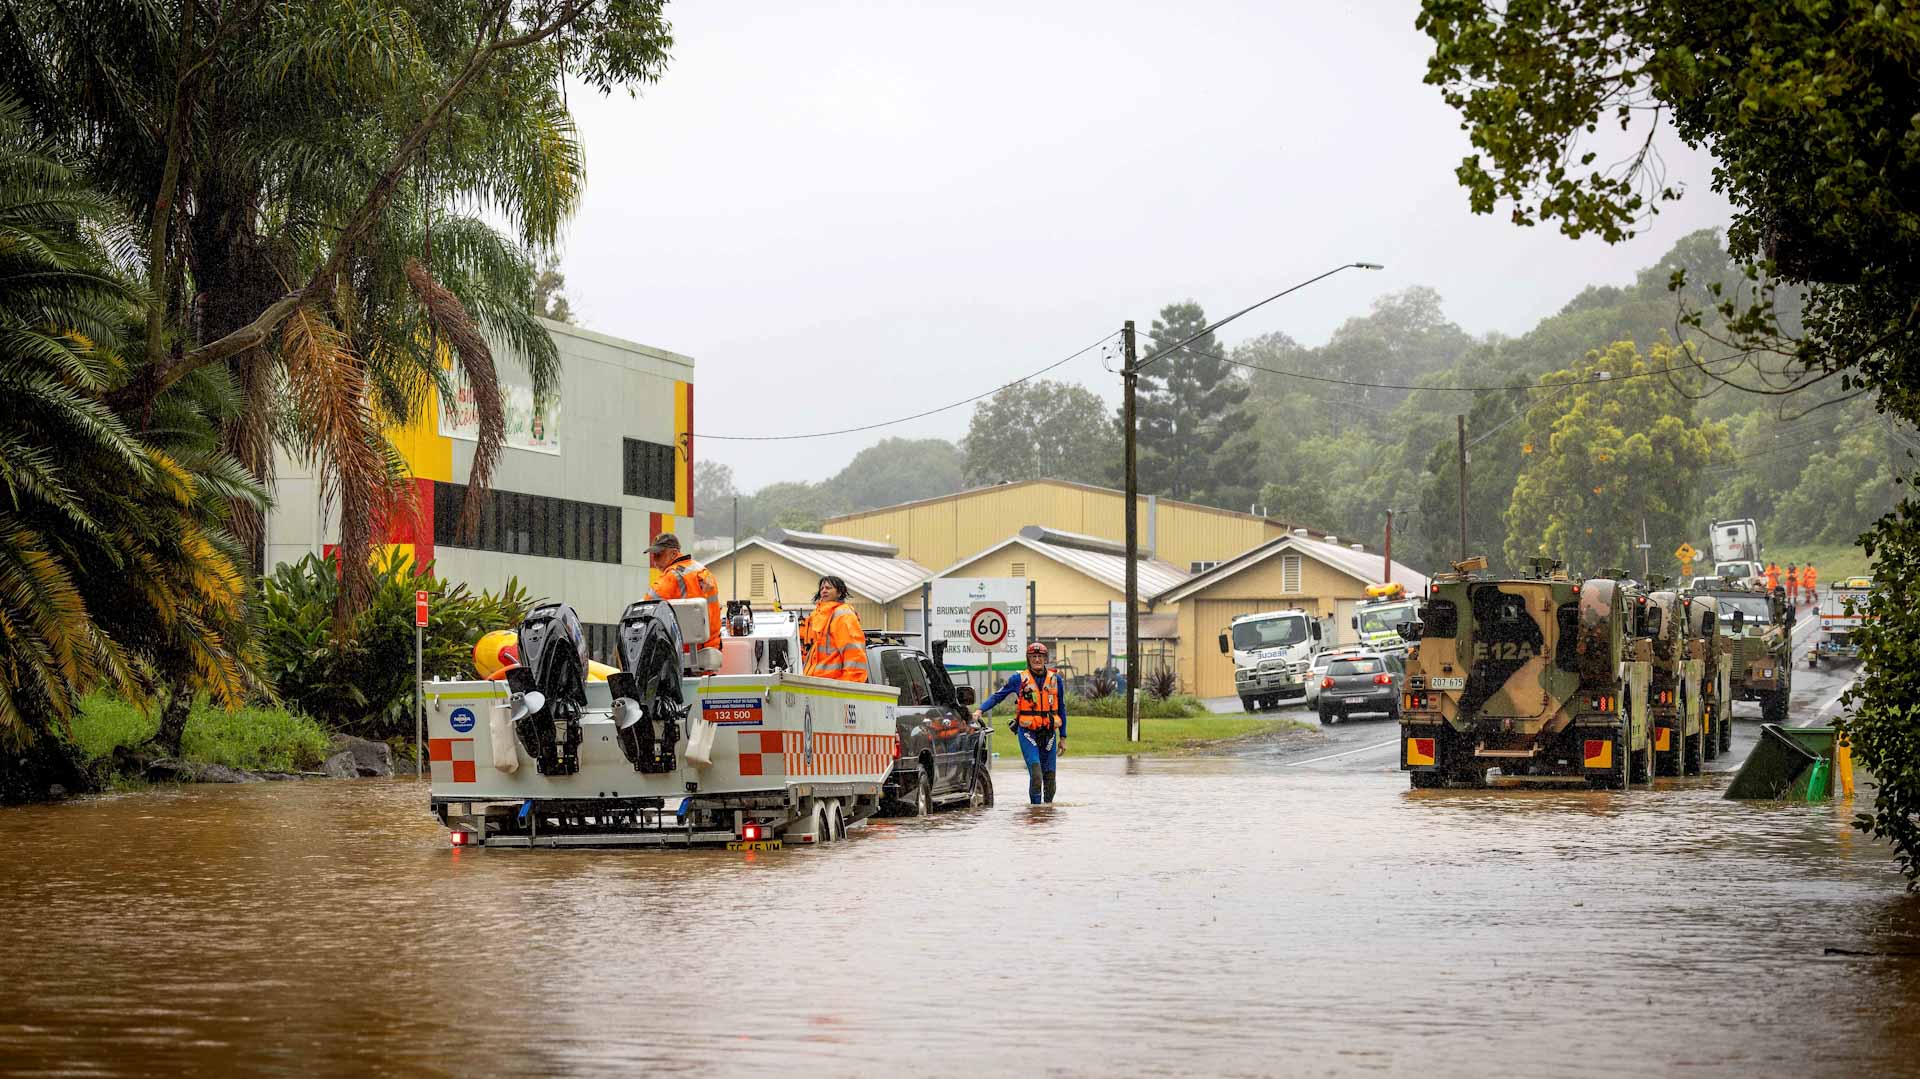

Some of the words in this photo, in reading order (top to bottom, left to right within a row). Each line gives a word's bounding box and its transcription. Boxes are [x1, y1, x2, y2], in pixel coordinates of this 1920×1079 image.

[936, 606, 971, 615] BRUNSWIC
[977, 618, 1001, 636] 60
[943, 630, 970, 639] COMMER
[1474, 641, 1534, 660] E12A
[715, 711, 731, 720] 132
[733, 710, 751, 719] 500
